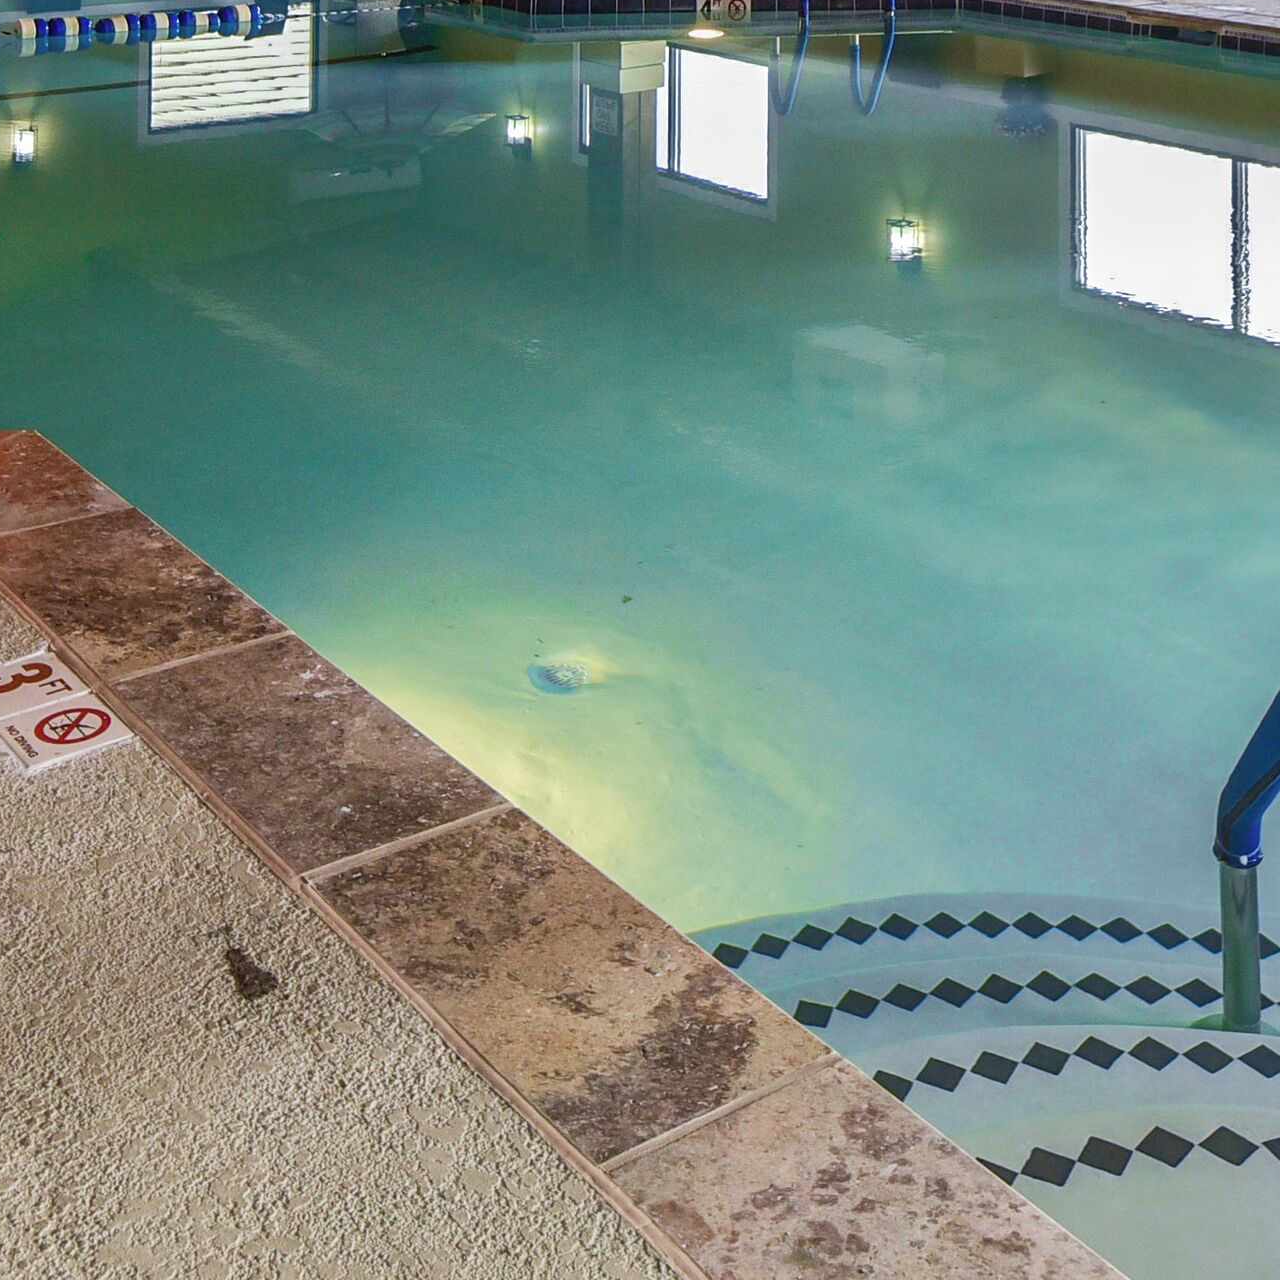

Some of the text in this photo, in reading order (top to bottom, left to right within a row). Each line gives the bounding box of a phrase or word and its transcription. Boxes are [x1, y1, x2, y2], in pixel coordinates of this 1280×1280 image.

[38, 678, 73, 696] FT
[7, 725, 39, 758] NO DIVING
